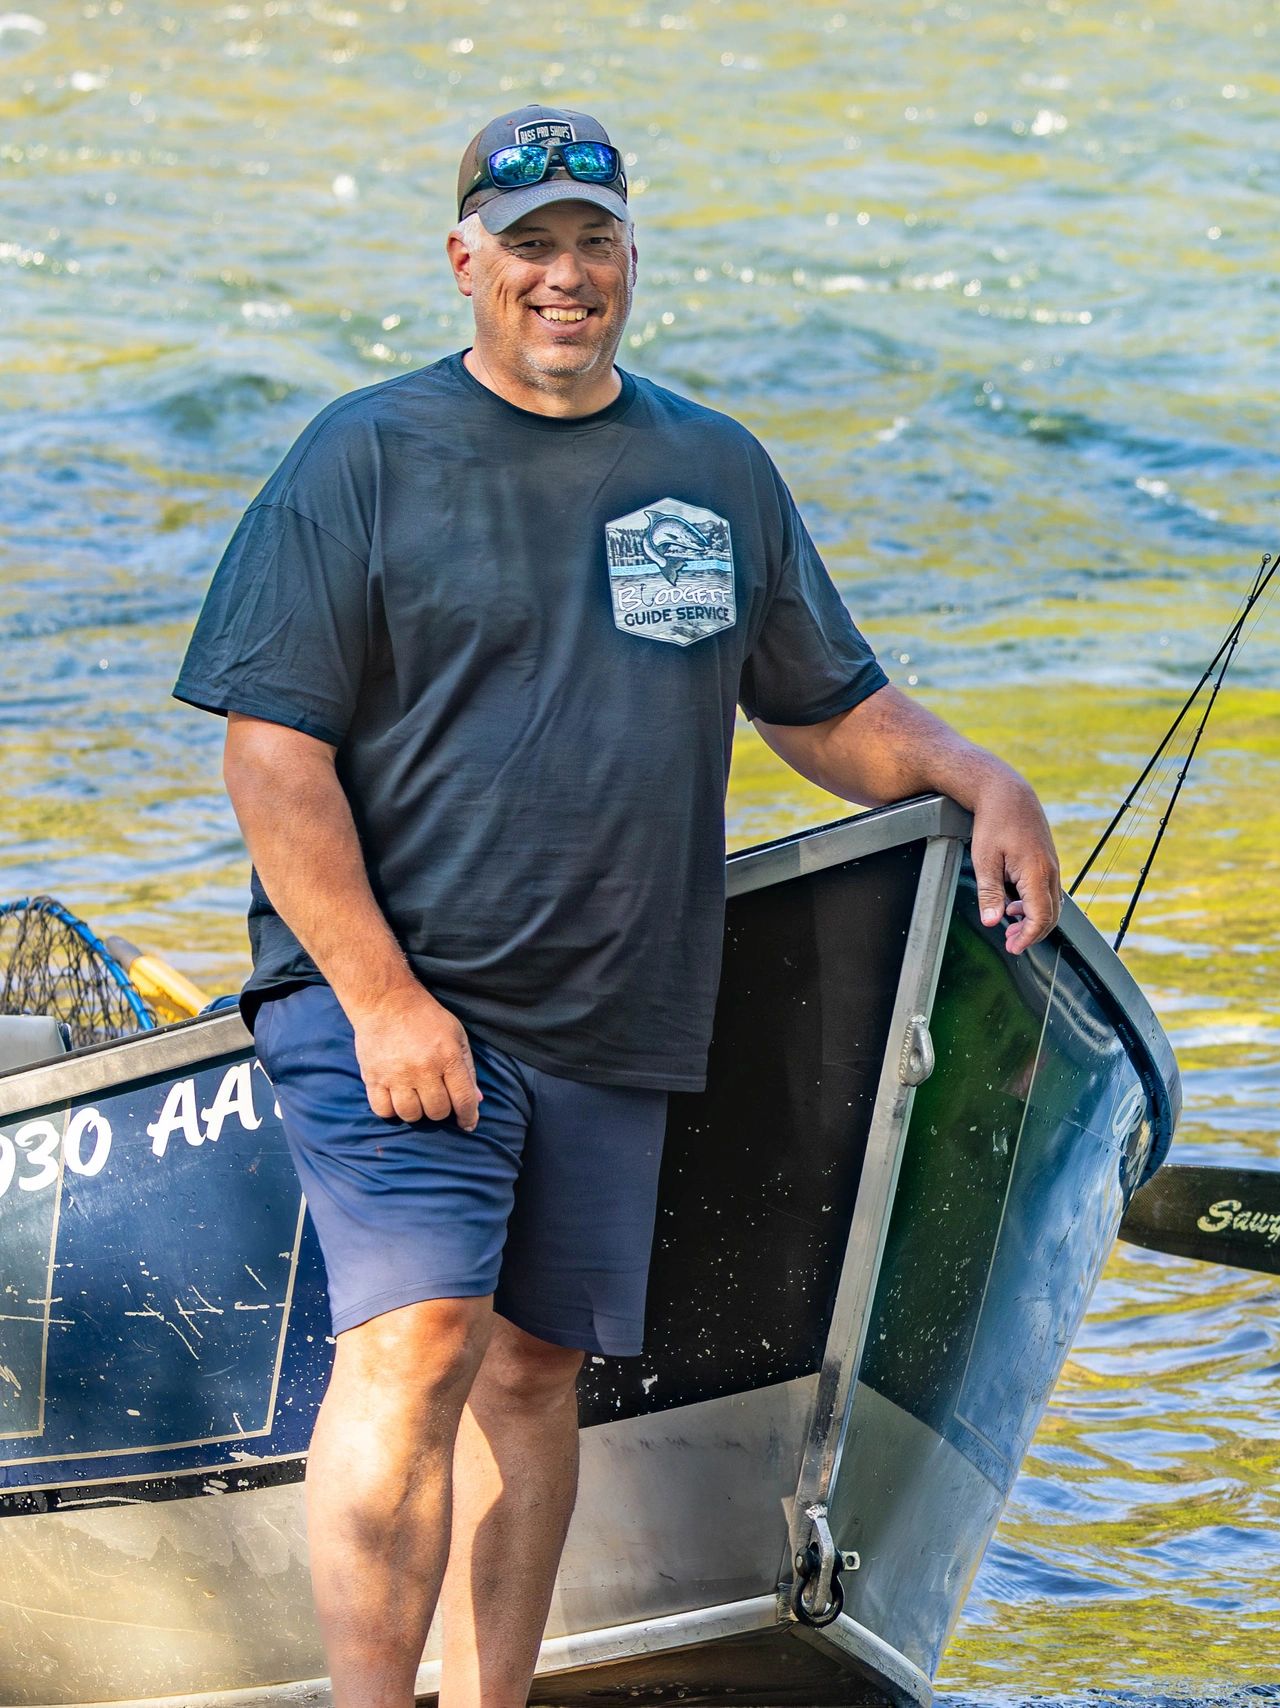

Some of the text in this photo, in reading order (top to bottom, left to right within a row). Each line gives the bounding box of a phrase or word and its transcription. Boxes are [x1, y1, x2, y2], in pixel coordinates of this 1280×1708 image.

[520, 125, 571, 144] BASS PRO SHOPS
[617, 584, 731, 611] BLODGETT
[624, 607, 730, 626] GUIDE SERVICE
[146, 1059, 284, 1158] AA
